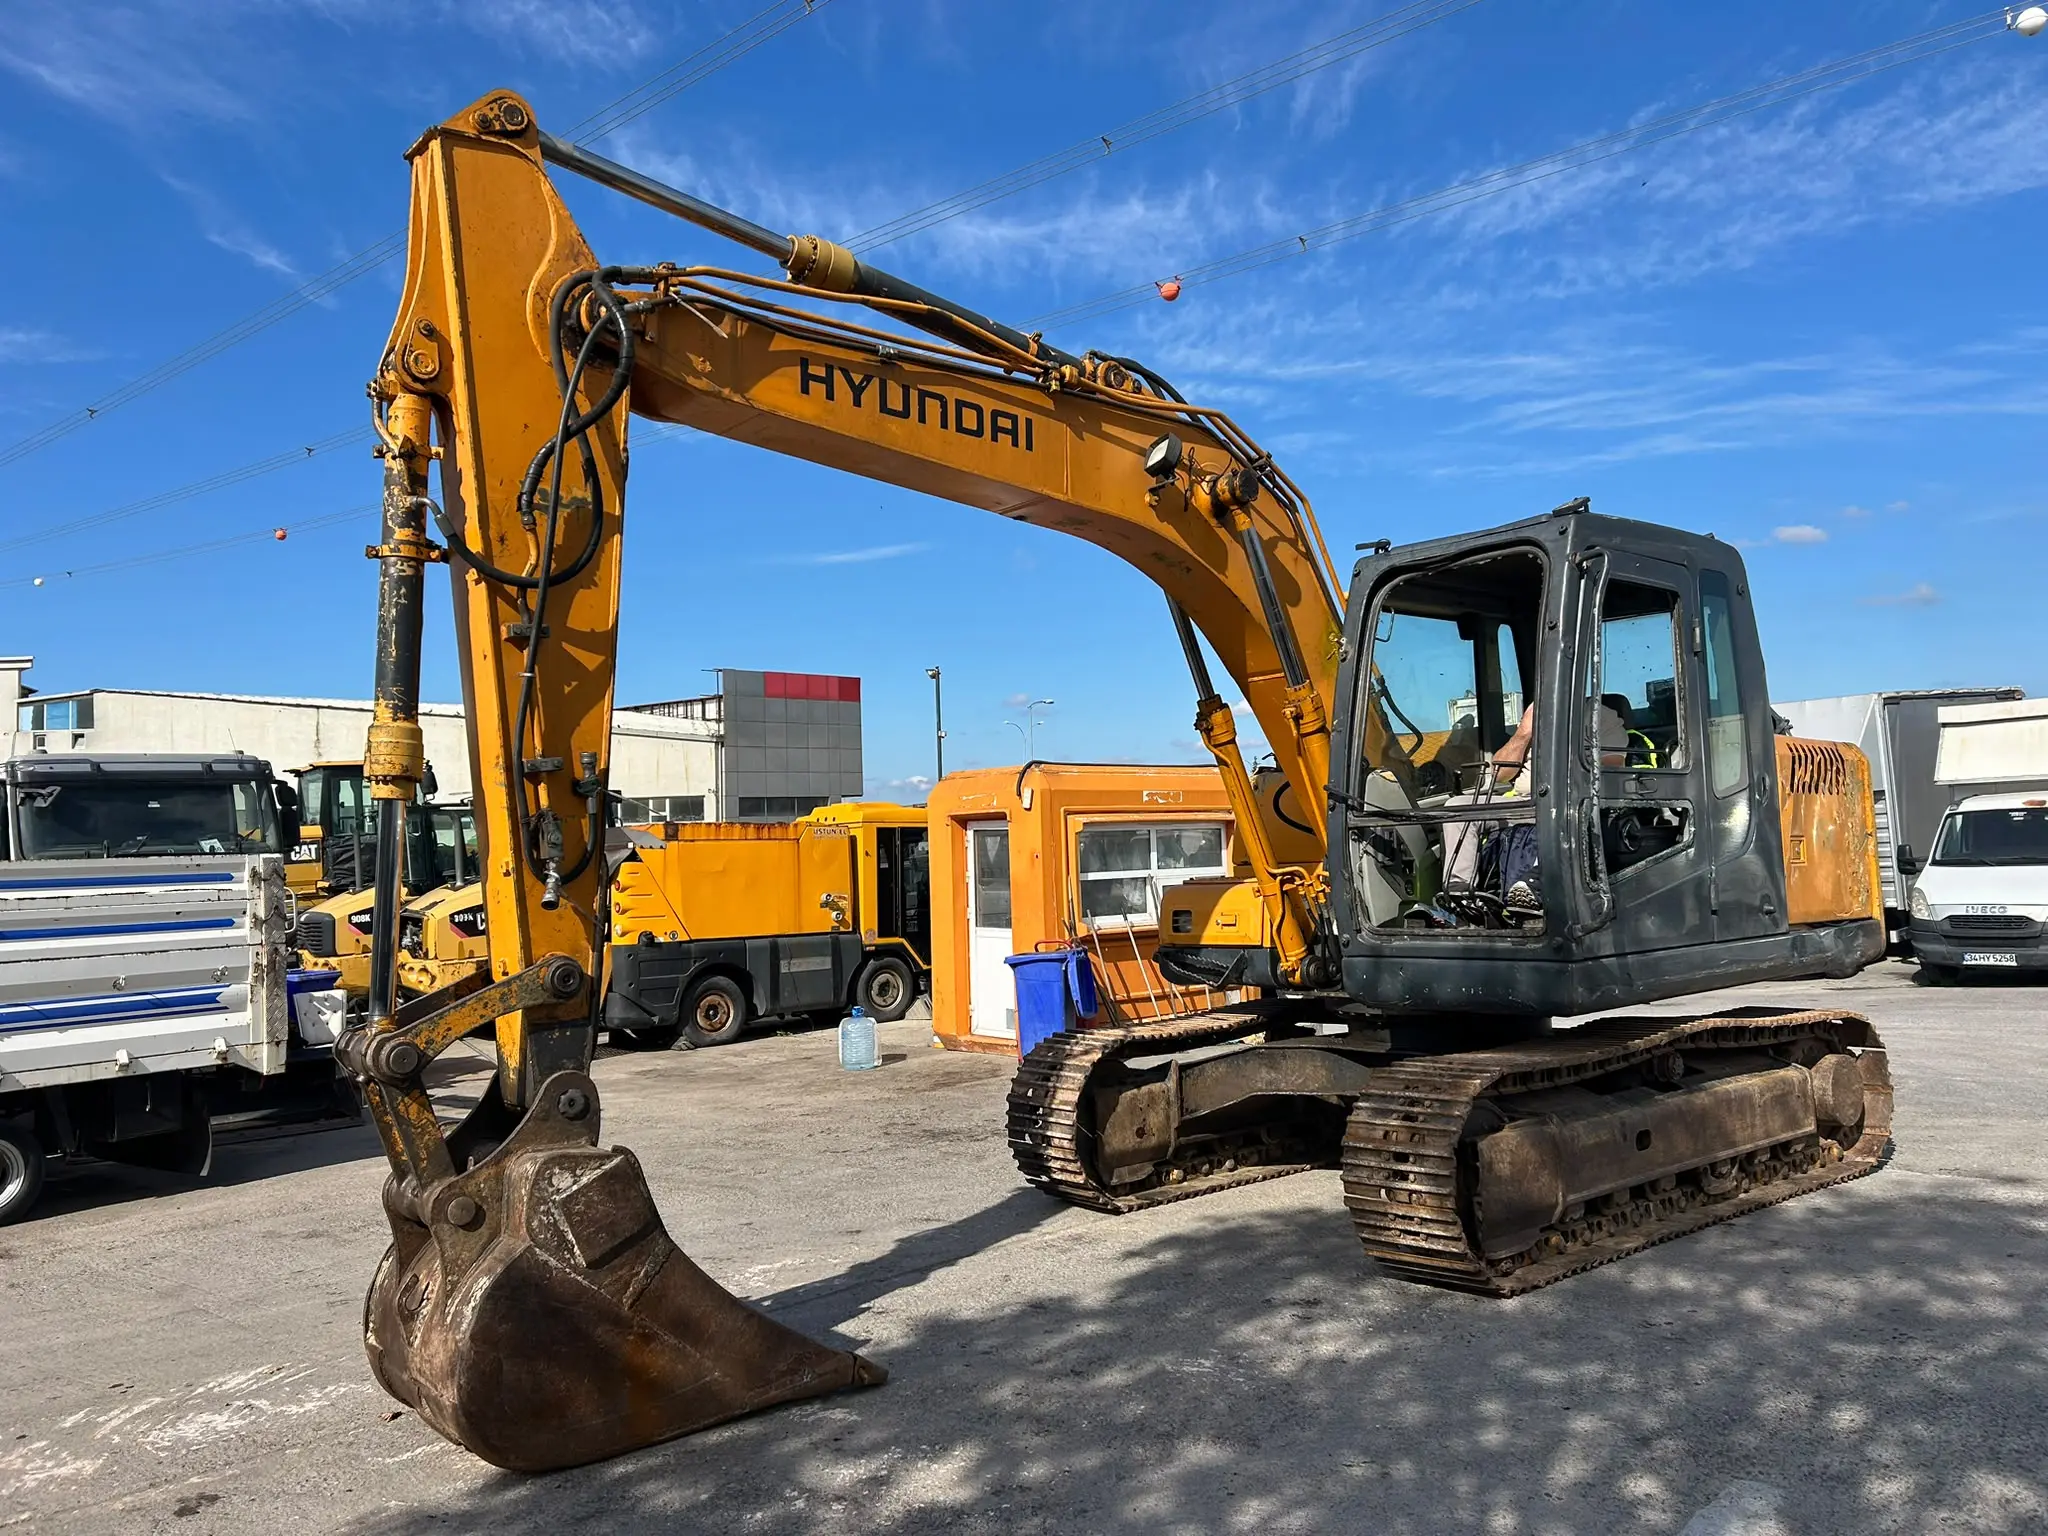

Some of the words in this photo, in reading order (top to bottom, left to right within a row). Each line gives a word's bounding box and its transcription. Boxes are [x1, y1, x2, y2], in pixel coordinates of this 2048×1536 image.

[800, 357, 1034, 452] HYUNDAI
[290, 844, 318, 861] CAT
[1965, 905, 2008, 914] IVECO
[351, 913, 371, 924] 908K
[1992, 954, 2015, 963] 5258
